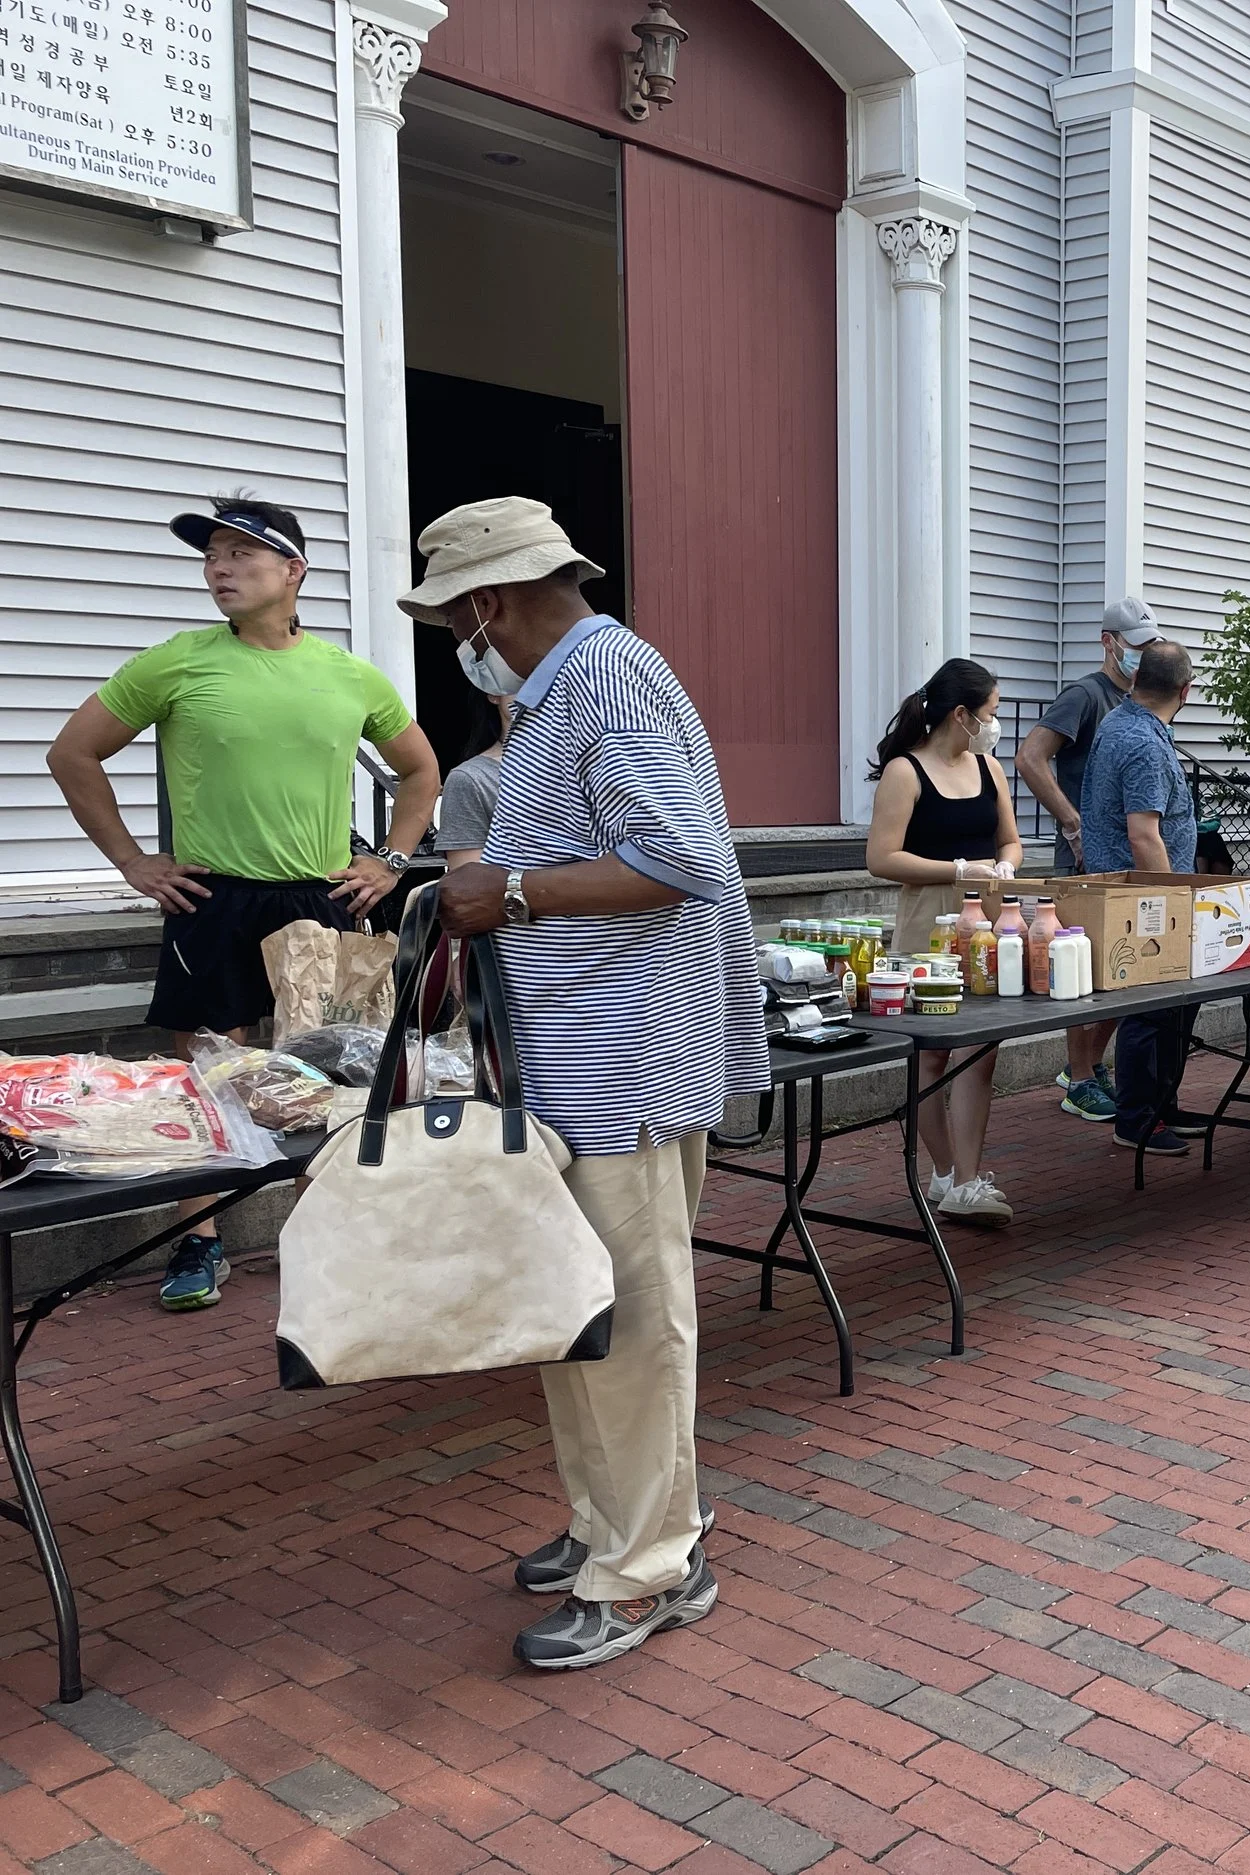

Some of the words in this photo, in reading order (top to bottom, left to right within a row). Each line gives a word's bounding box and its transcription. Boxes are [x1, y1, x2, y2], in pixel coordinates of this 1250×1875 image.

[123, 3, 155, 26] 오후
[165, 16, 212, 43] 8:00
[121, 32, 153, 56] 오전
[166, 44, 210, 69] 5:35
[164, 74, 212, 101] 토요일
[0, 123, 71, 151] ultaneous
[75, 140, 154, 171] Translation
[124, 124, 156, 146] 오후
[167, 134, 212, 158] 5:30
[28, 144, 77, 170] During
[81, 156, 114, 176] Main
[119, 165, 169, 189] Service
